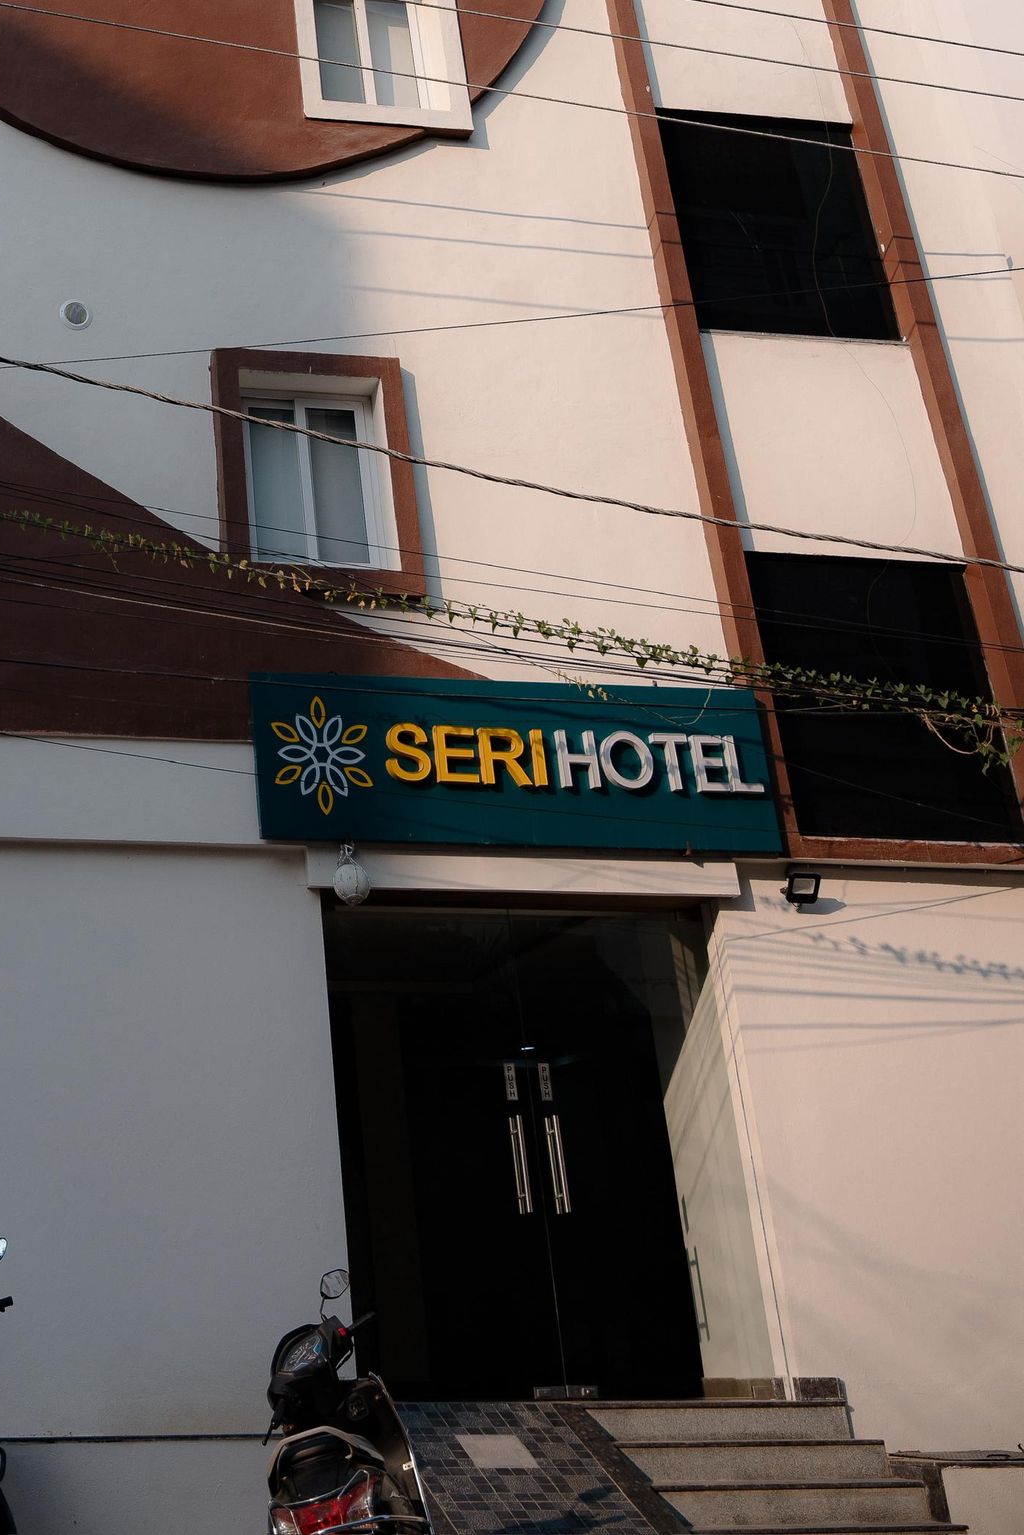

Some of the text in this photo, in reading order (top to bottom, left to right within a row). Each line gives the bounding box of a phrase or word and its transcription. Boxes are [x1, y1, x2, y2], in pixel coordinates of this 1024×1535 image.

[385, 723, 764, 793] SERI HOTEL
[507, 1065, 516, 1097] PUSH
[541, 1066, 550, 1097] PUSH
